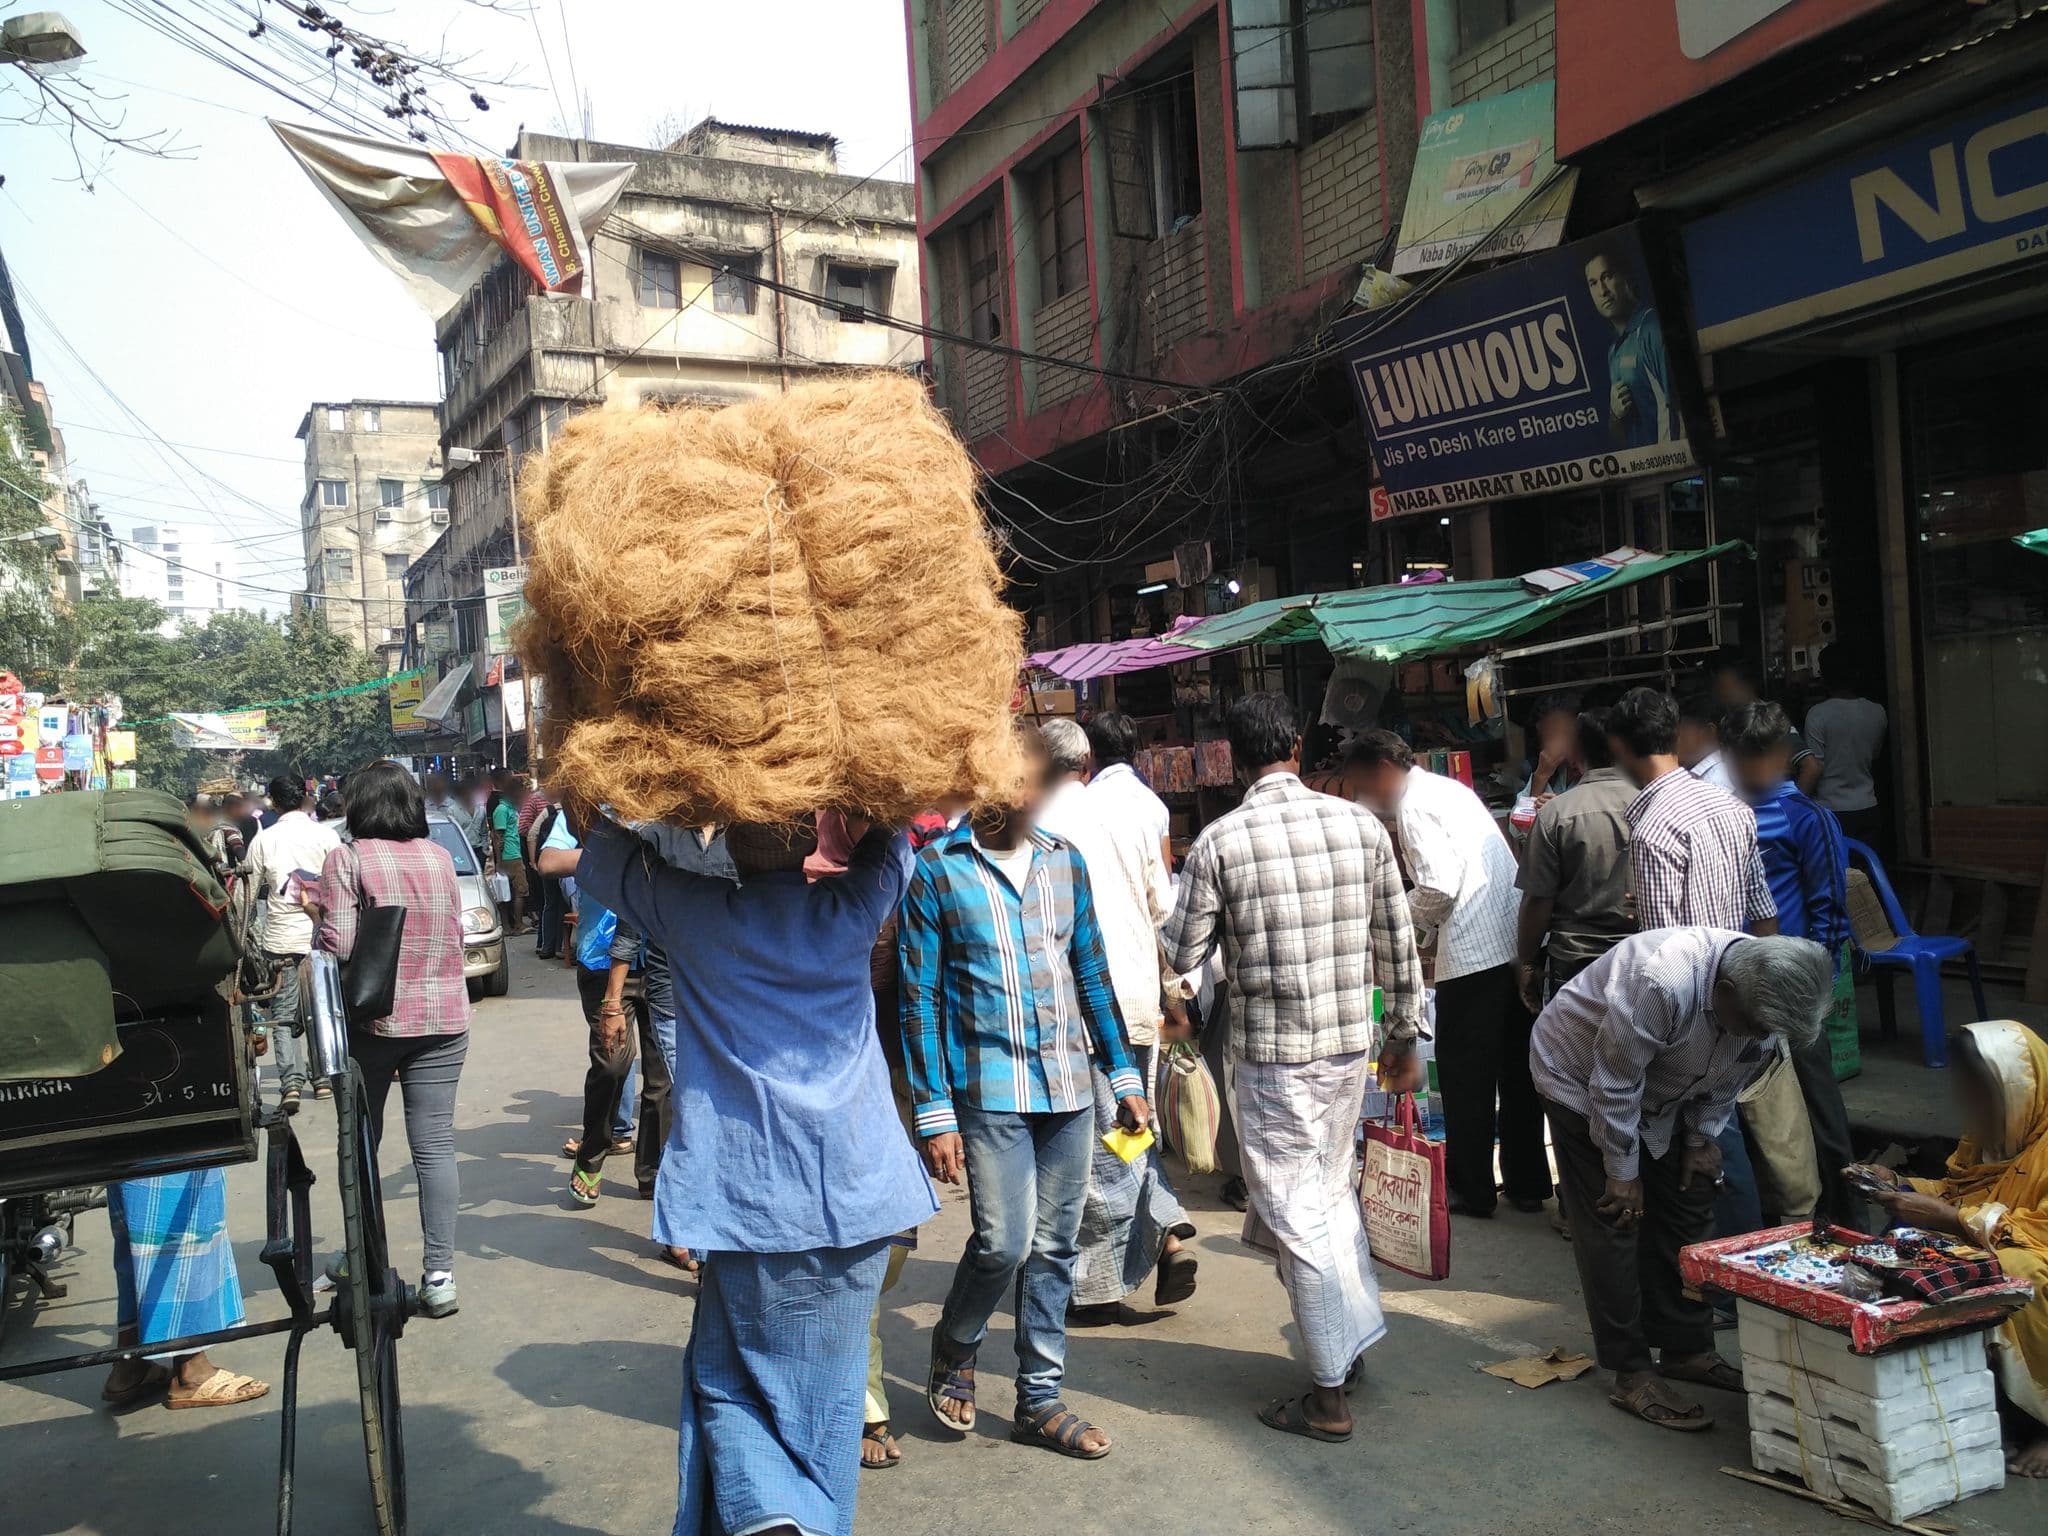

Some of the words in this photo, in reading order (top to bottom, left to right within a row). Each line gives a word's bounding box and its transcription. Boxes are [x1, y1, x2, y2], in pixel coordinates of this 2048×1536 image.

[510, 171, 543, 236] UNITED
[548, 205, 571, 257] Chandni
[1419, 245, 1444, 264] Naba
[1361, 313, 1578, 429] LUMINOUS
[1382, 446, 1405, 468] Jis
[1405, 441, 1429, 464] Pe
[1431, 429, 1473, 458] Desh
[1474, 422, 1517, 448] Kare
[1519, 405, 1600, 438] Bharosa
[1394, 488, 1441, 514] NABA
[1443, 475, 1516, 506] BHARAT
[1521, 458, 1584, 492] RADIO
[1590, 454, 1628, 479] CO.
